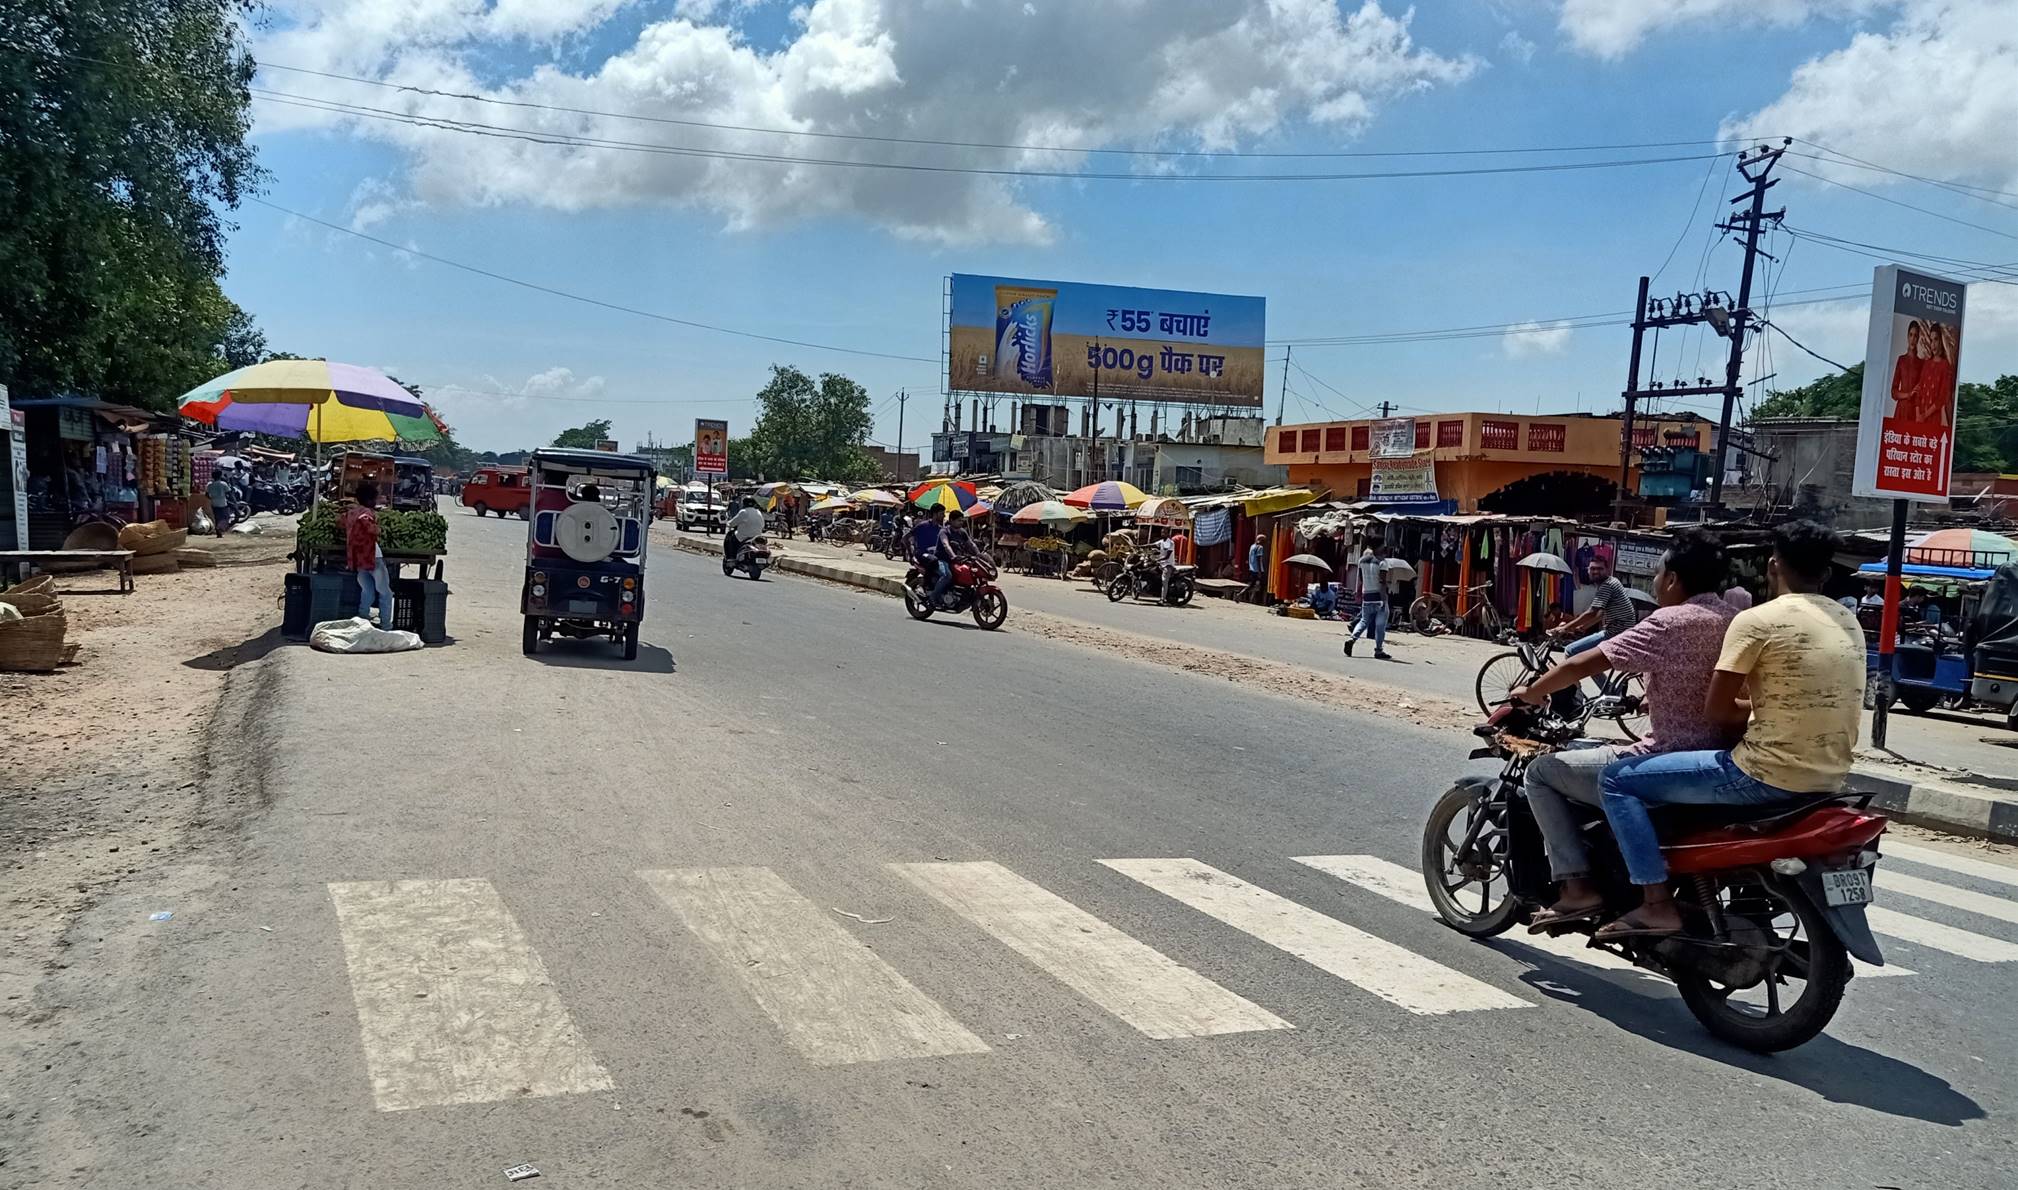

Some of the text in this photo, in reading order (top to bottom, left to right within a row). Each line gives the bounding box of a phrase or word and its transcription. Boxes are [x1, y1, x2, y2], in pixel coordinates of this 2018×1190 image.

[1912, 284, 1957, 309] TRENDS
[1020, 313, 1037, 374] Horlicks
[1087, 346, 1153, 380] 500g
[1159, 345, 1194, 374] पैक
[1883, 430, 1902, 445] इंडिया
[1903, 432, 1911, 445] के
[1912, 434, 1927, 448] सबसे
[1886, 447, 1908, 462] परिधान
[1924, 454, 1933, 465] का
[1901, 467, 1912, 480] इस
[1913, 467, 1925, 481] ओर
[1926, 468, 1932, 481] है
[600, 576, 621, 584] G-7
[1841, 887, 1866, 902] 1258
